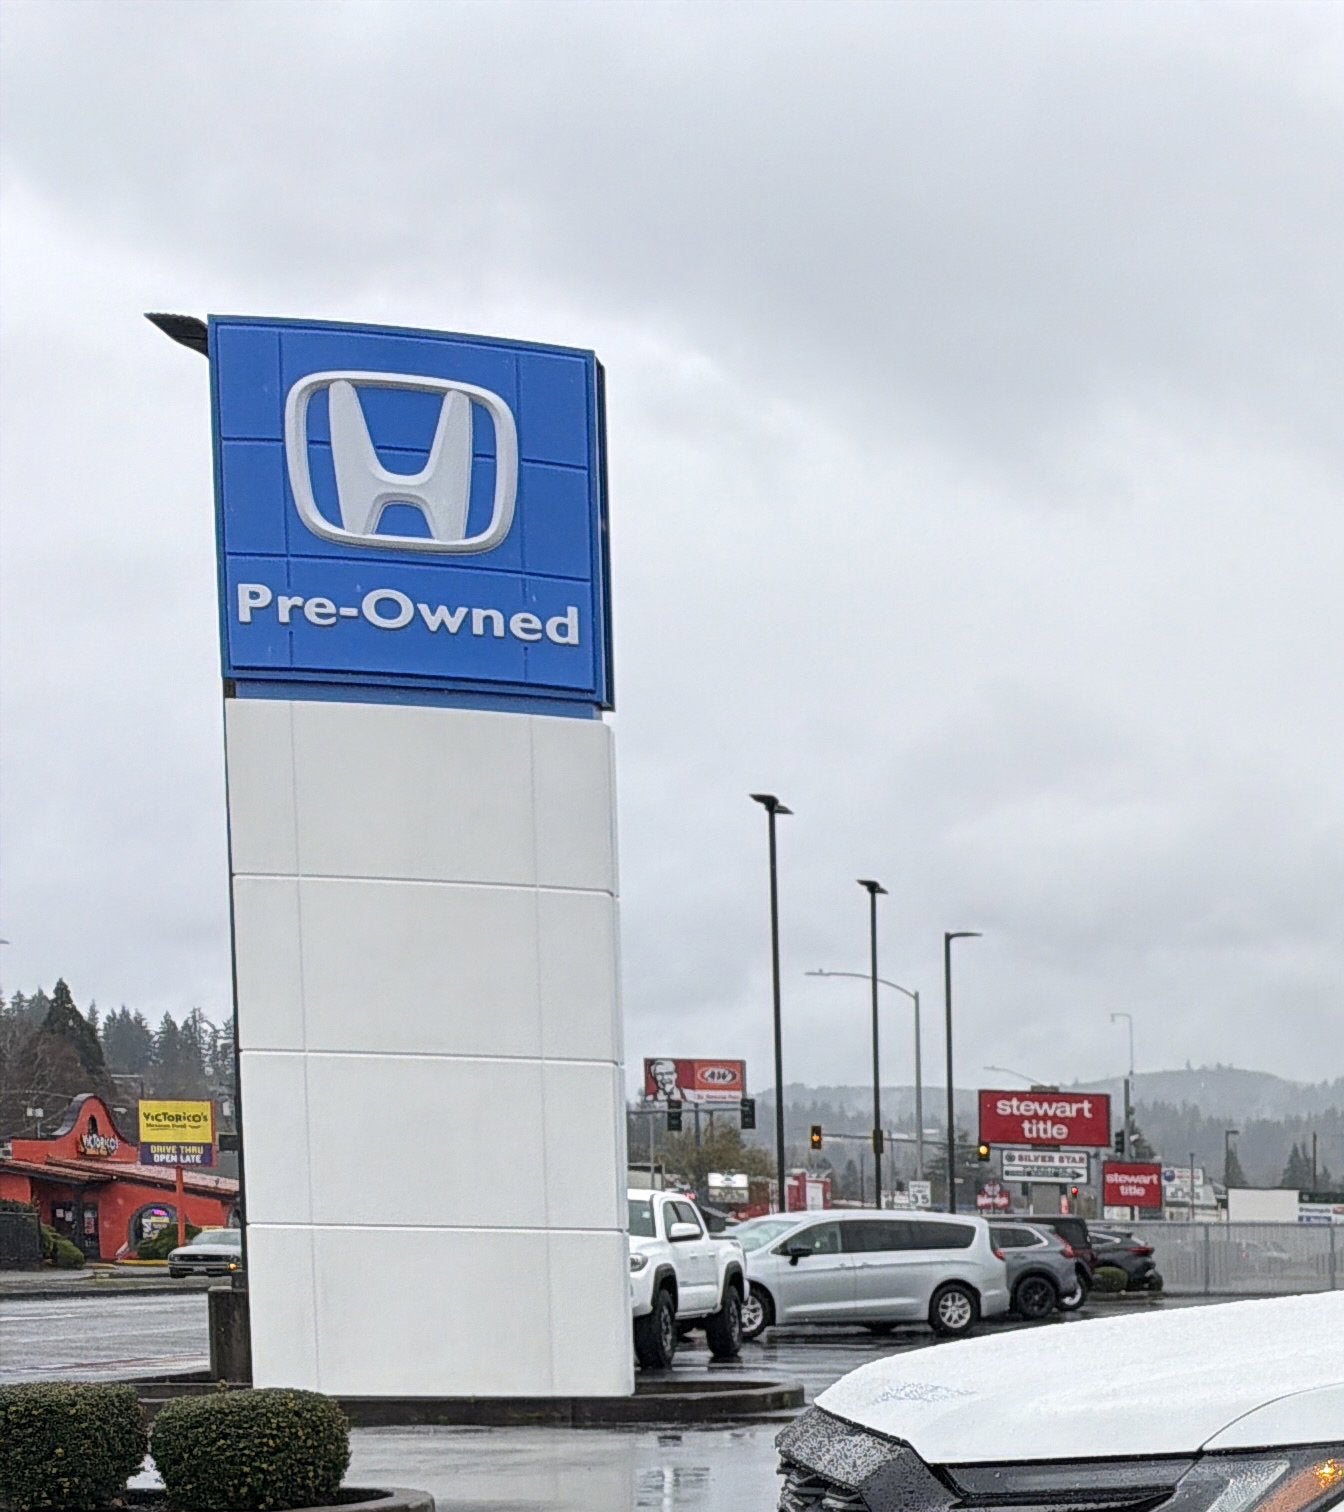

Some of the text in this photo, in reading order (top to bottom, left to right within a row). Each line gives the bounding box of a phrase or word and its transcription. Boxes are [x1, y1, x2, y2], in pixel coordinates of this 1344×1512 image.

[237, 583, 580, 645] Pre-Owned
[996, 1097, 1093, 1118] stewart
[1021, 1119, 1068, 1139] title
[150, 1145, 204, 1154] DRIVE THRU
[153, 1154, 202, 1163] OPEN LATE
[1018, 1154, 1085, 1164] SILVER STAR
[1105, 1173, 1158, 1184] stewart
[1119, 1185, 1145, 1197] title
